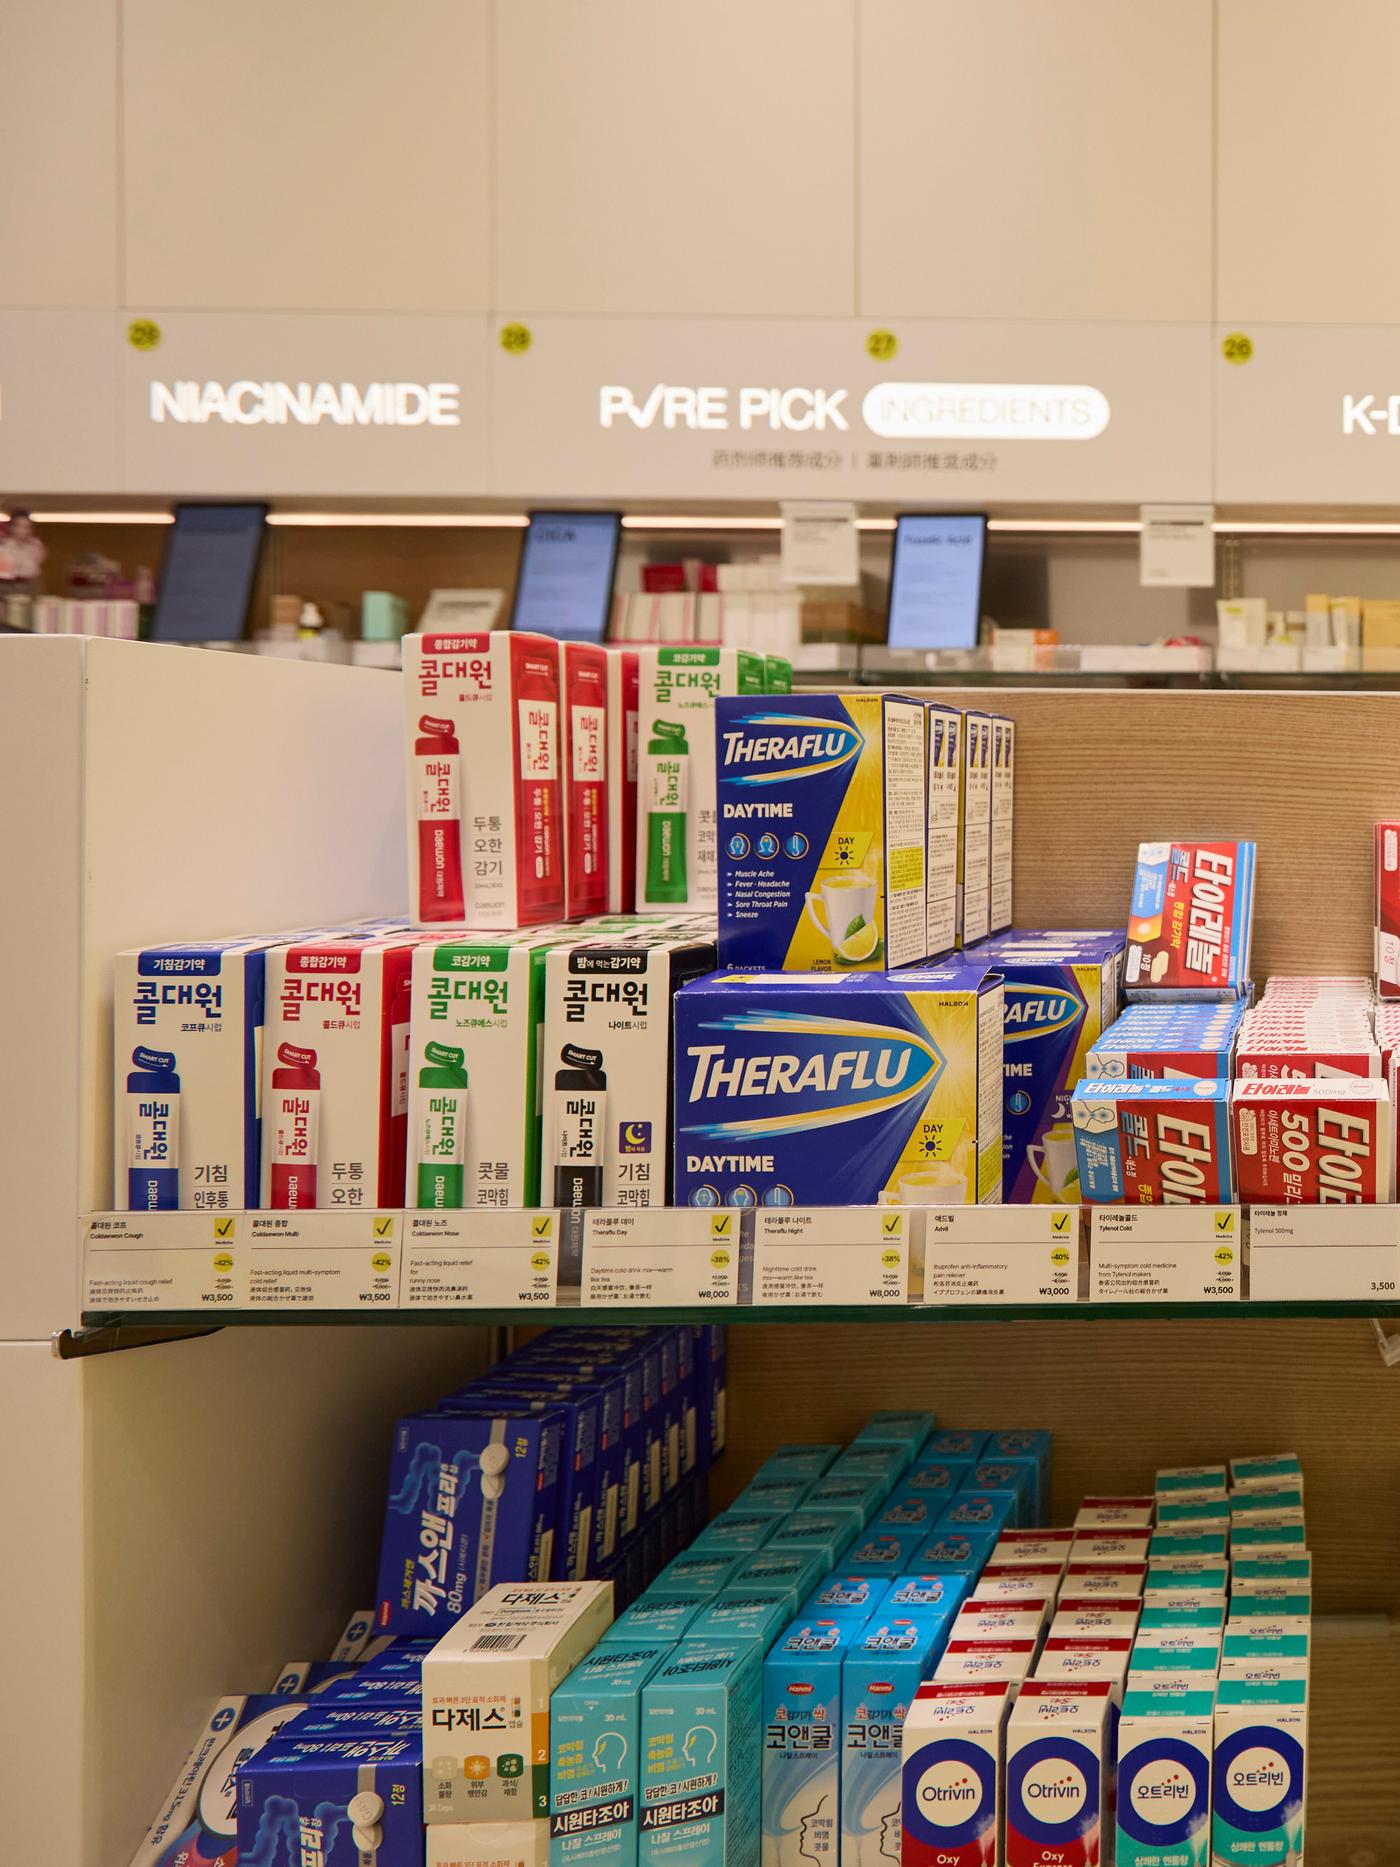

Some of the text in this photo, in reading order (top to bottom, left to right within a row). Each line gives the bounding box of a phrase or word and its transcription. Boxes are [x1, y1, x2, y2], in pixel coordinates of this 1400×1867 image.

[151, 381, 460, 426] NIACINAMIDE
[740, 388, 849, 431] PICK
[881, 395, 1092, 426] INGREDIENTS
[418, 659, 492, 697] 콜대원
[654, 670, 720, 703] 콜대원
[723, 727, 847, 766] THERAFLU
[723, 802, 793, 819] DAYTIME
[473, 816, 502, 833] 두통
[474, 838, 502, 854] 오한
[838, 837, 855, 845] DAY
[474, 860, 503, 877] 감기
[735, 870, 774, 878] Muscle Ache
[735, 880, 790, 888] Fever Headache
[735, 890, 791, 900] Nasal Congestion
[735, 900, 788, 909] Sore Throat Pain
[1185, 849, 1234, 975] 타이레놀
[735, 911, 759, 919] Sneeze
[153, 958, 205, 971] 기침감기약
[299, 955, 347, 968] 종합감기약
[450, 955, 491, 967] 코감기약
[133, 981, 222, 1025] 콜대원
[280, 978, 361, 1022] 콜대원
[427, 977, 508, 1020] 콜대원
[563, 980, 648, 1023] 콜대원
[180, 1022, 222, 1032] 코프큐시럽
[687, 1045, 913, 1104] THERAFLU
[923, 1124, 944, 1134] DAY
[331, 1162, 364, 1181] 두통
[477, 1162, 509, 1180] 콧물
[618, 1163, 650, 1182] 기침
[686, 1155, 775, 1173] DAYTIME
[194, 1164, 228, 1183] 기침
[193, 1190, 229, 1209] 인후통
[330, 1187, 364, 1206] 오한
[476, 1188, 509, 1206] 코막힘
[617, 1189, 650, 1207] 코막힘
[1099, 1214, 1138, 1222] 타이레놀콜드
[1254, 1227, 1273, 1235] Tylenol
[698, 1290, 729, 1299] ₩8,000
[869, 1288, 900, 1298] ₩8,000
[1039, 1287, 1070, 1297] ₩3,000
[1203, 1286, 1234, 1295] ₩3,500
[1371, 1281, 1395, 1291] 3,500
[201, 1293, 233, 1303] ₩3,500
[359, 1293, 391, 1302] ₩3,500
[518, 1291, 550, 1301] ₩3,500
[412, 1510, 451, 1617] 까스앤
[446, 1573, 467, 1615] 80mg
[431, 1707, 507, 1732] 다제스
[775, 1706, 811, 1722] 코감기가
[766, 1725, 833, 1751] 코앤쿨
[1233, 1771, 1285, 1787] 오트리빈
[391, 1784, 406, 1806] 12정
[922, 1784, 976, 1802] Otrivin
[1027, 1782, 1081, 1800] Otrivin
[1137, 1783, 1190, 1800] 오트리빈
[554, 1800, 630, 1833] 시원타조아
[643, 1795, 719, 1827] 시원타조아
[810, 1818, 834, 1829] 코막힘
[936, 1853, 960, 1866] Oxy
[1041, 1851, 1064, 1864] Oxy
